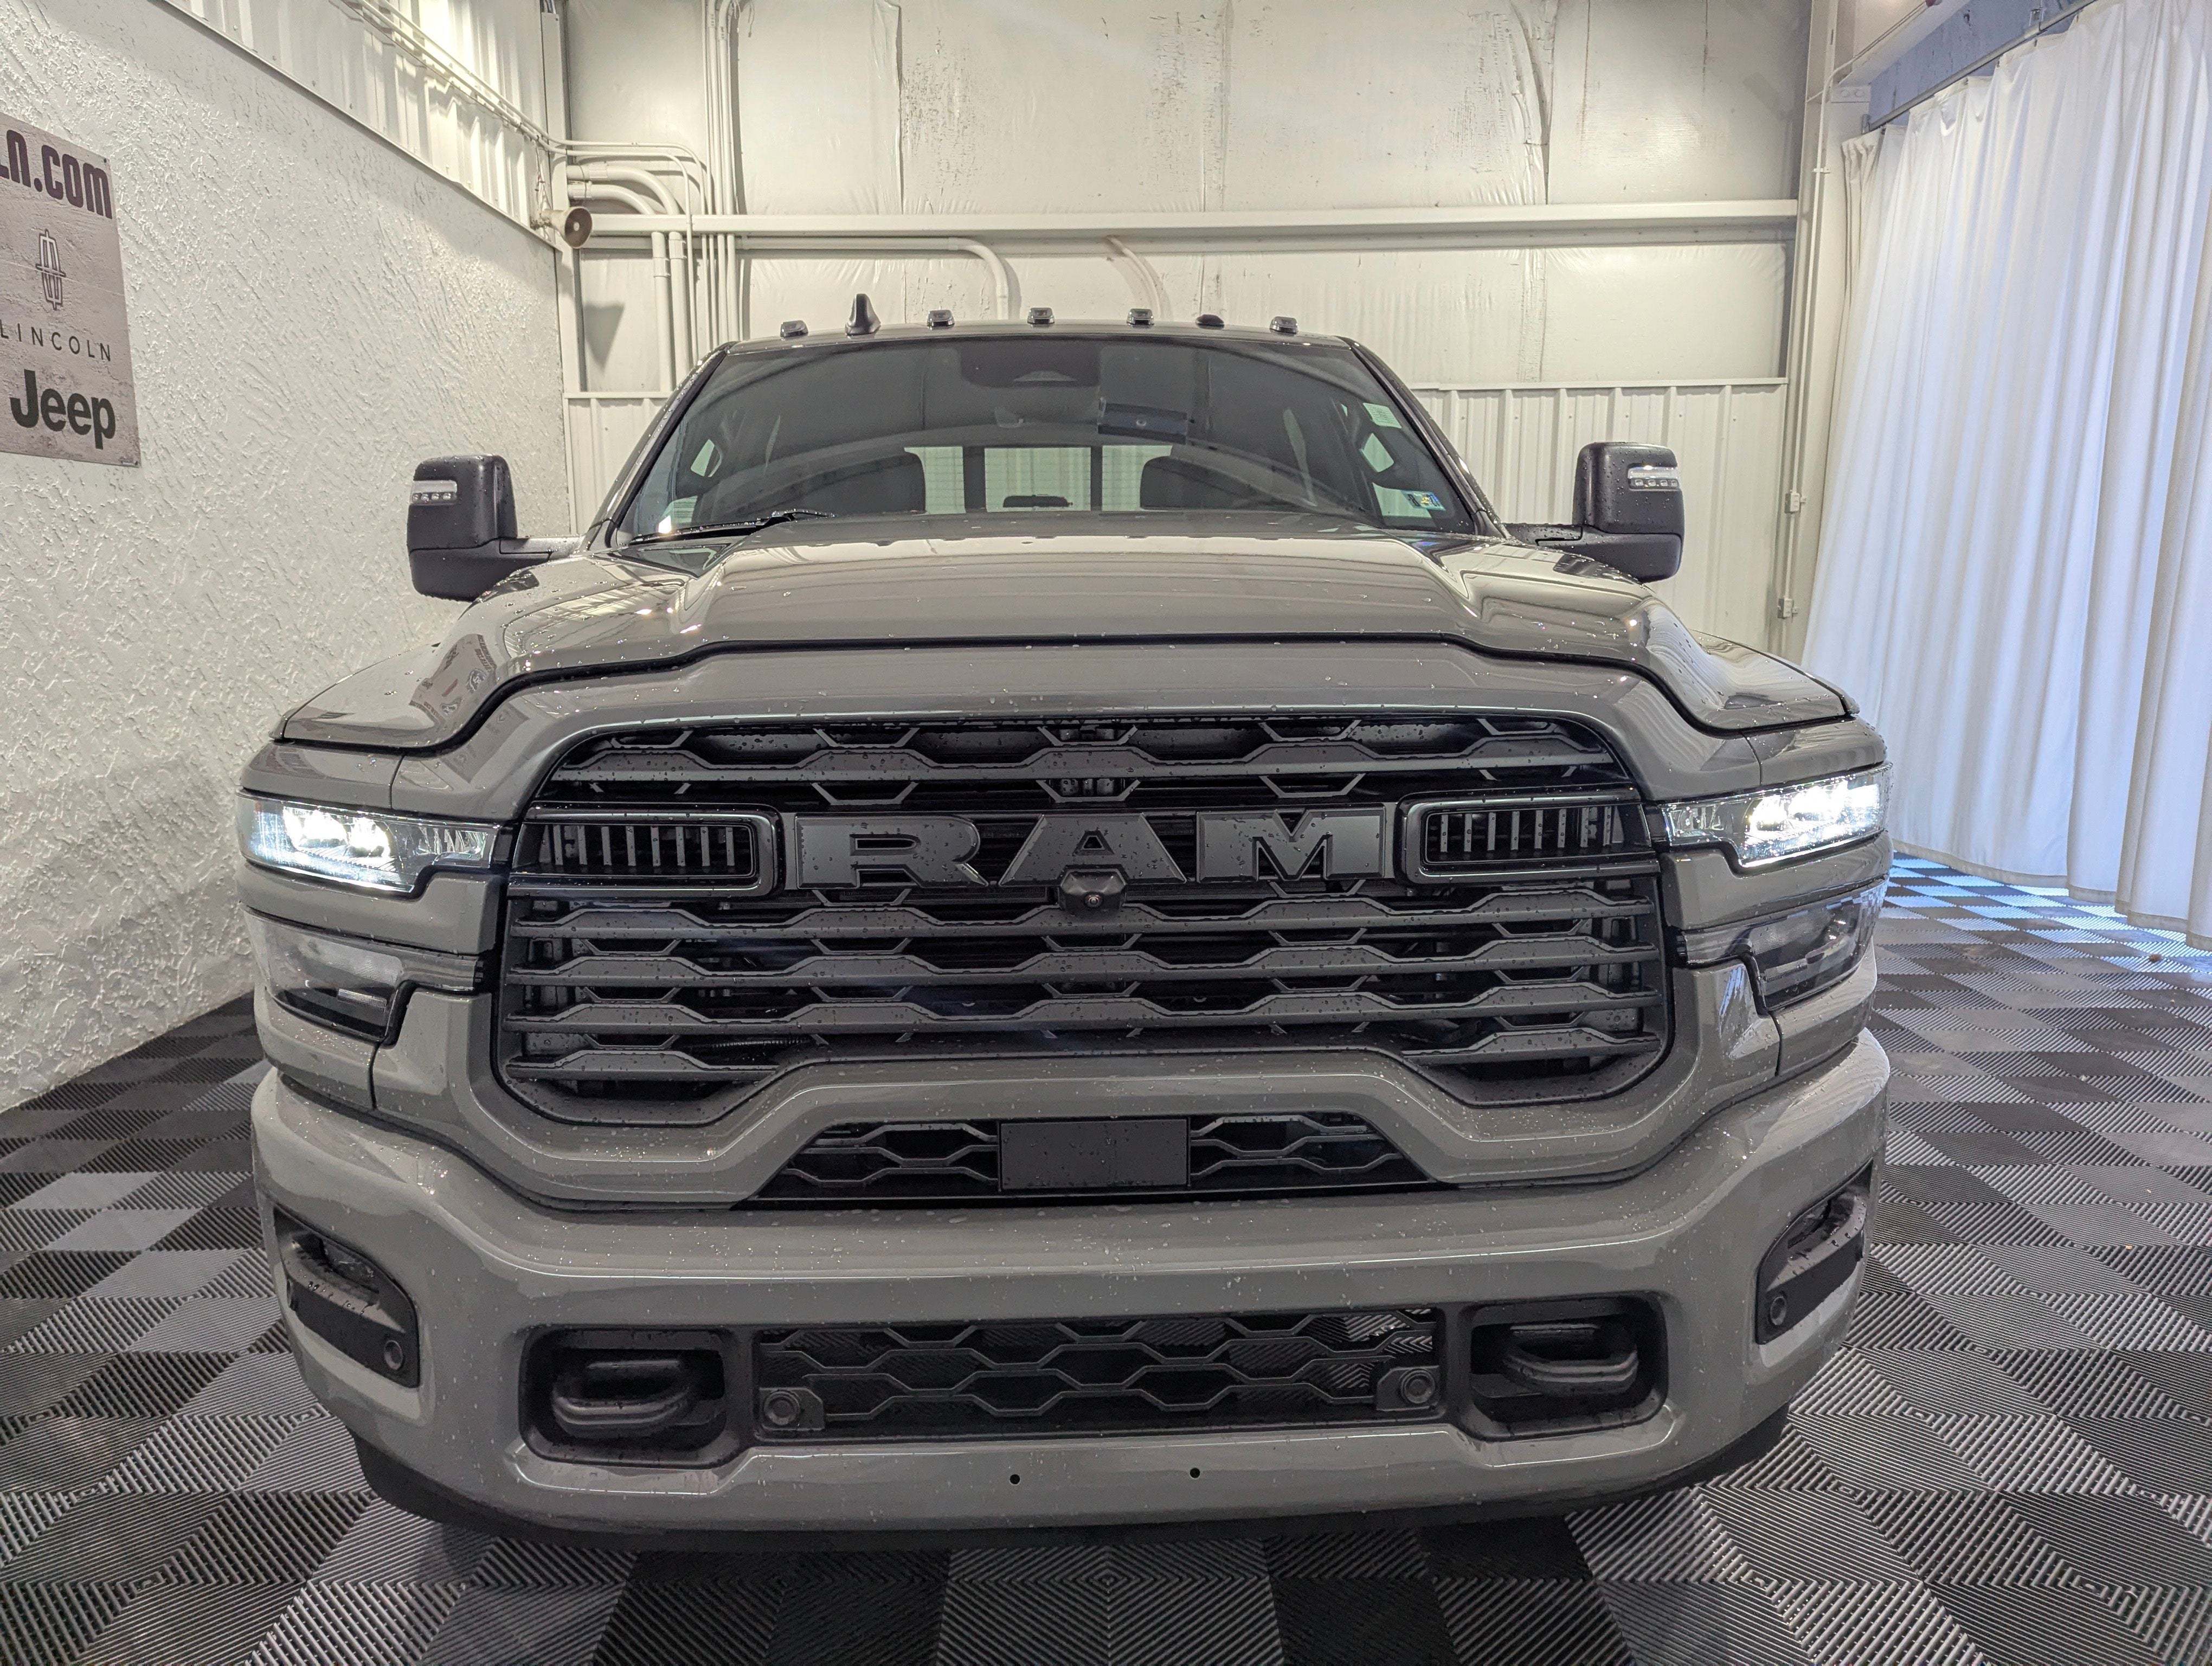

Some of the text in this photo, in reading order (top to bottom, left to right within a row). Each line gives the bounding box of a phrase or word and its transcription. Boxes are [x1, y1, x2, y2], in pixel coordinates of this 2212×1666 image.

[0, 319, 111, 362] LINCOLN
[10, 369, 115, 450] Jeep
[795, 809, 1385, 889] RAM
